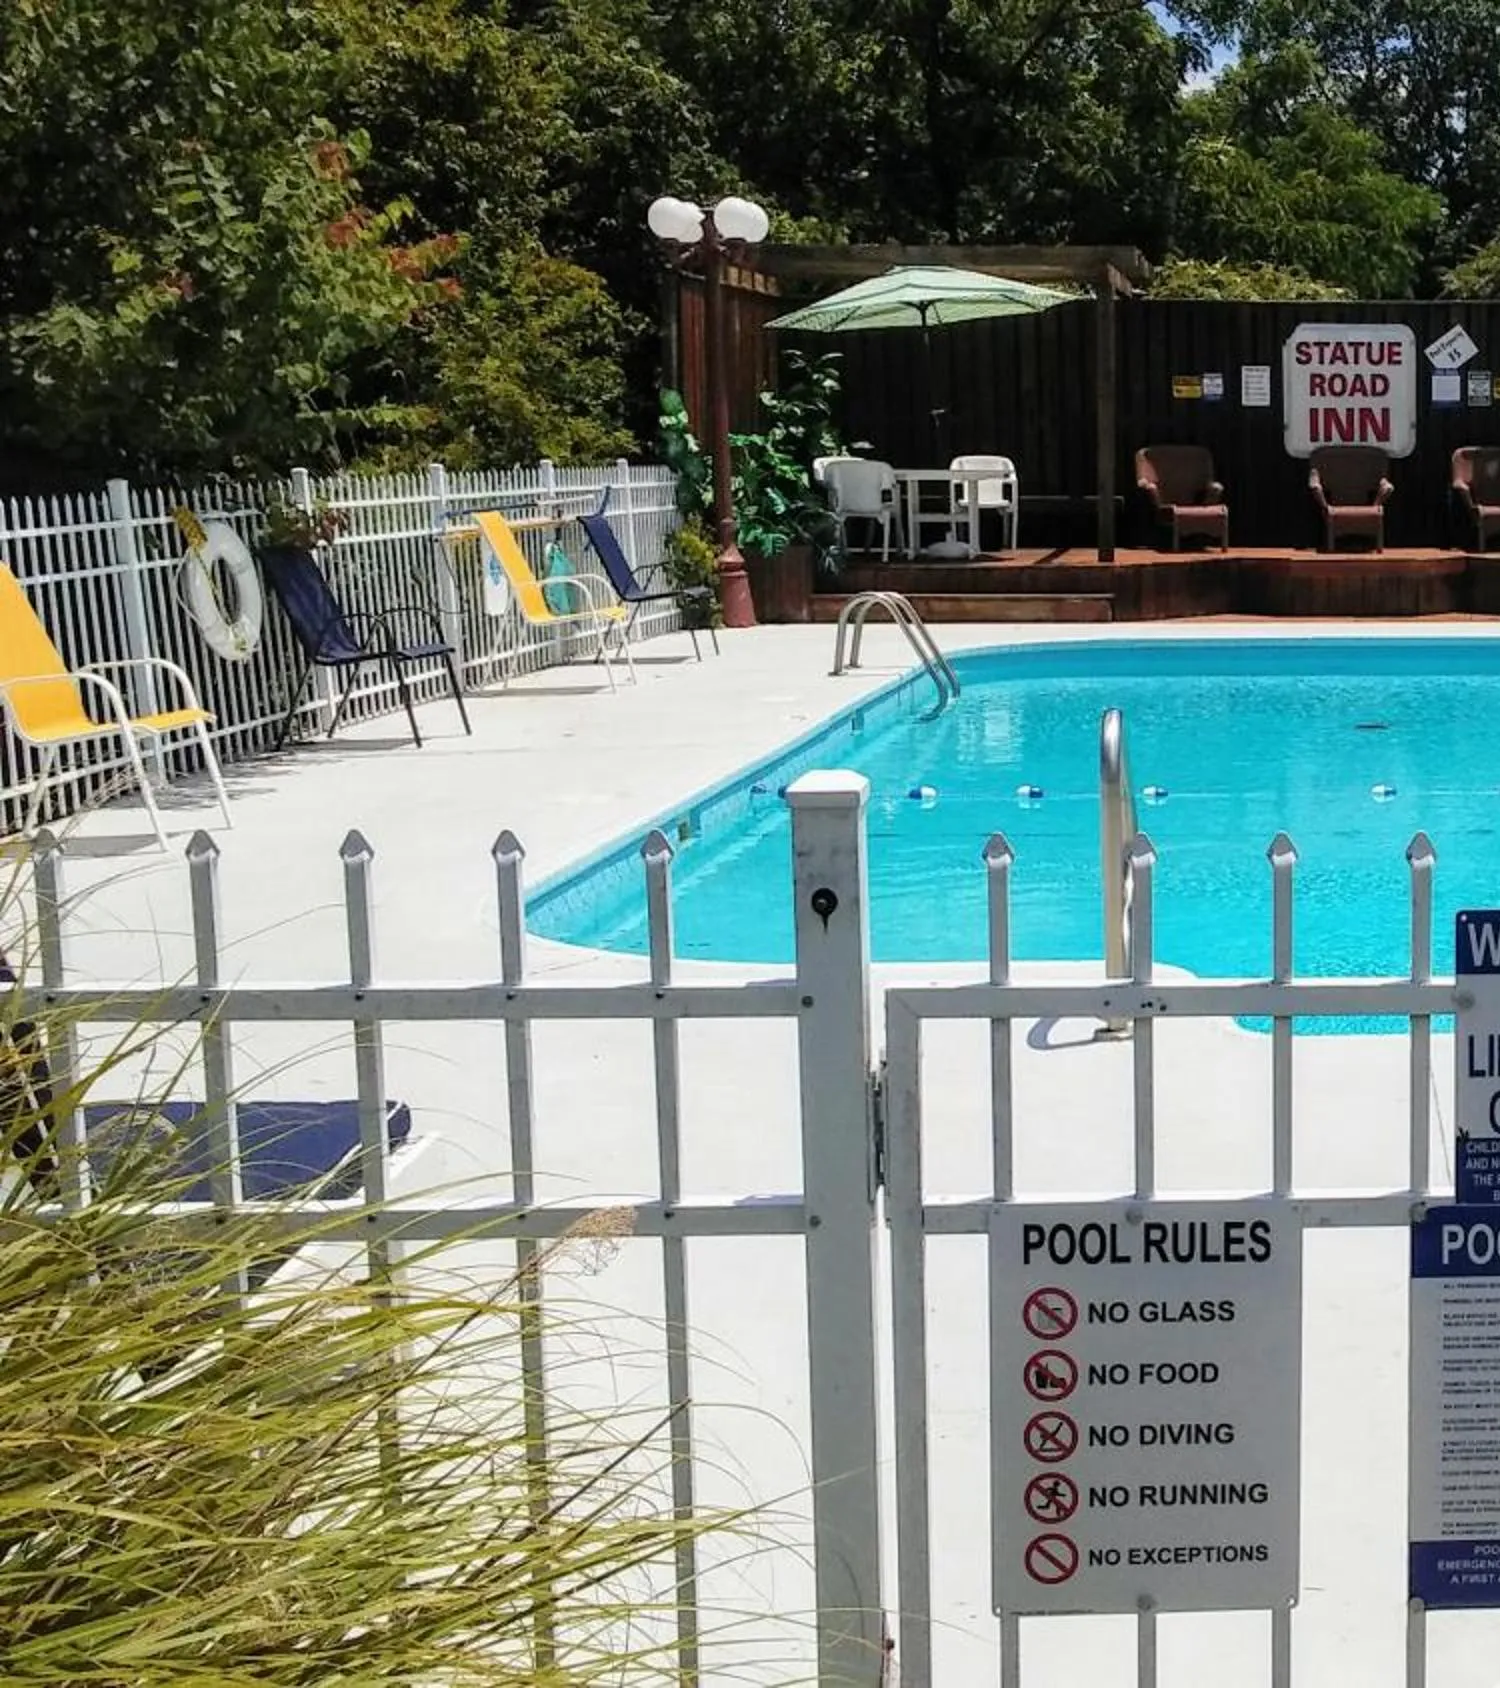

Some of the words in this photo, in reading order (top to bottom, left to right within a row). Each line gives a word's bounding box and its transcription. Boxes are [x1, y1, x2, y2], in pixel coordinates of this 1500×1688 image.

[1295, 341, 1403, 366] STATUE
[1309, 373, 1390, 397] ROAD
[1309, 407, 1391, 443] INN
[1466, 1157, 1489, 1169] AND
[1473, 1172, 1494, 1186] THE
[1023, 1222, 1131, 1265] POOL
[1143, 1219, 1272, 1263] RULES
[1088, 1302, 1129, 1324] NO
[1139, 1300, 1236, 1323] GLASS
[1088, 1364, 1129, 1385] NO
[1138, 1362, 1220, 1385] FOOD
[1088, 1425, 1130, 1447] NO
[1138, 1423, 1236, 1446] DIVING
[1088, 1486, 1130, 1508] NO
[1138, 1483, 1270, 1507] RUNNING
[1088, 1548, 1121, 1567] NO
[1128, 1545, 1270, 1566] EXCEPTIONS
[1450, 1575, 1460, 1584] A
[1461, 1573, 1496, 1585] FIRST
